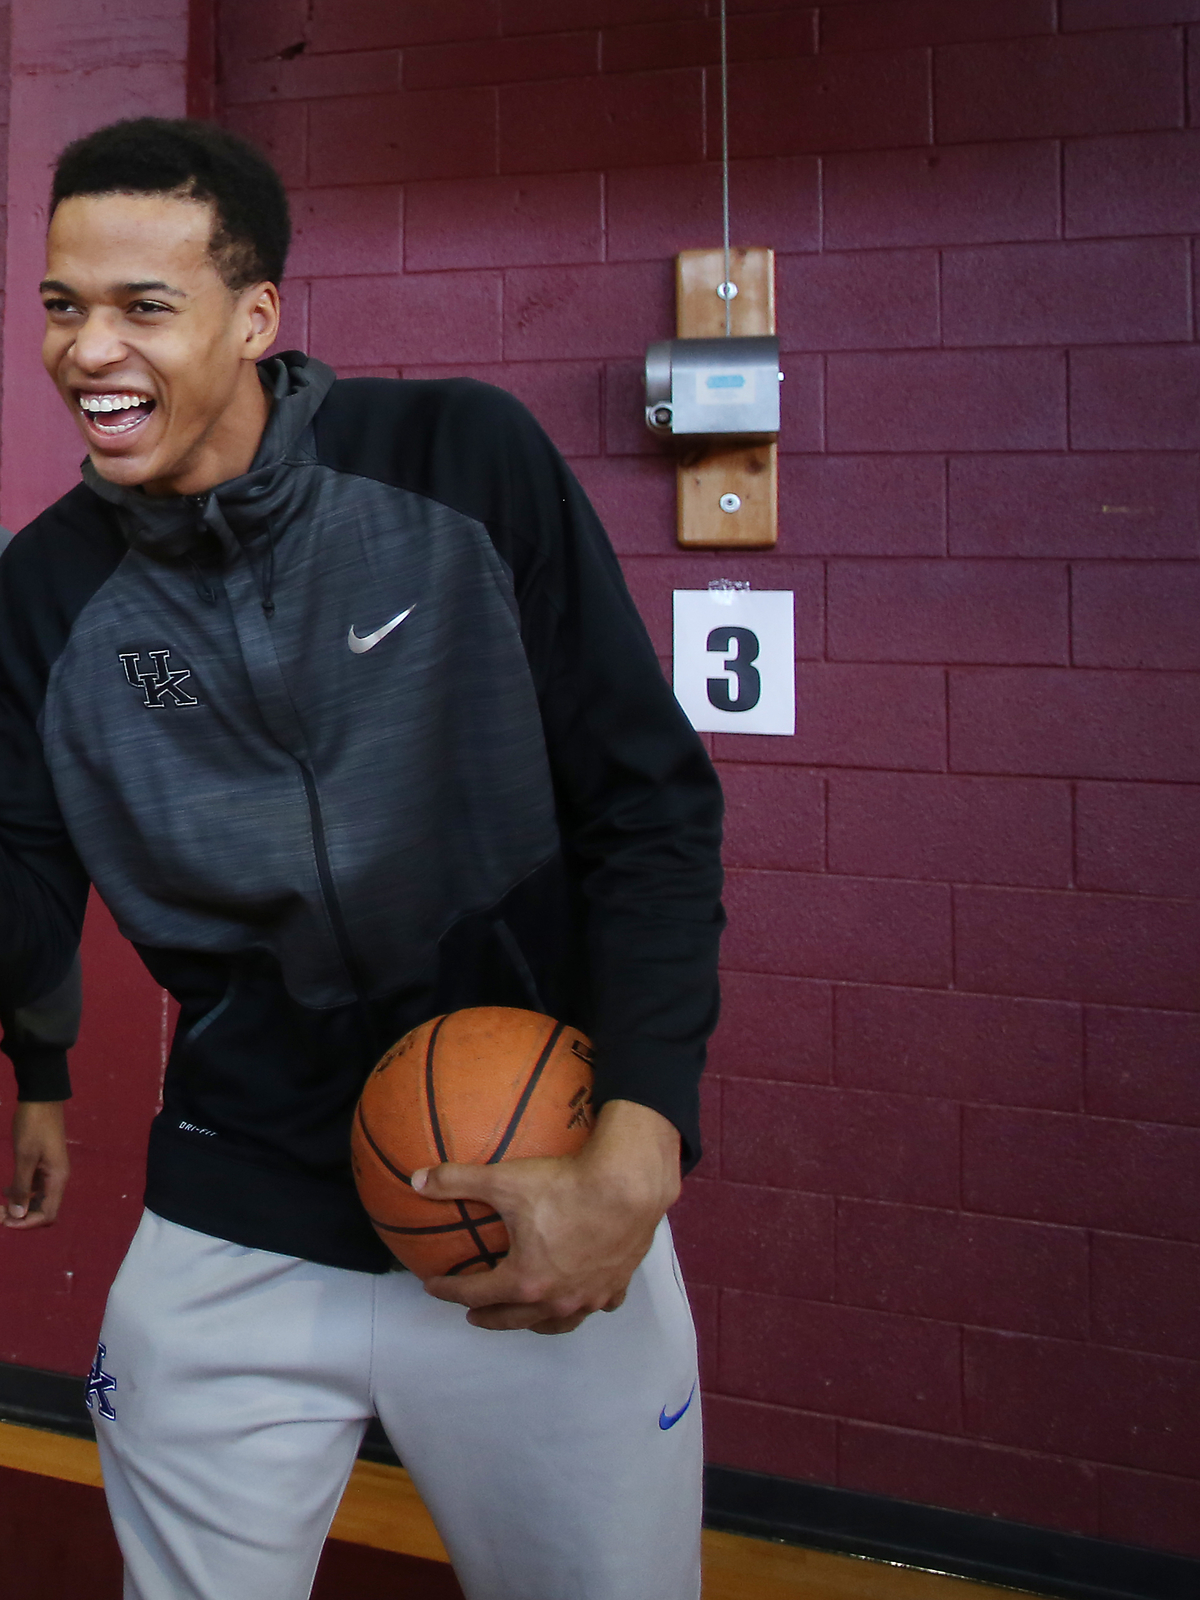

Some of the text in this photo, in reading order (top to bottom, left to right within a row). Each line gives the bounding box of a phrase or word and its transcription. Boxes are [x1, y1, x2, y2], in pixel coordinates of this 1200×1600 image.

[118, 649, 198, 708] UK
[706, 626, 761, 712] 3
[178, 1120, 217, 1137] DRI-FIT
